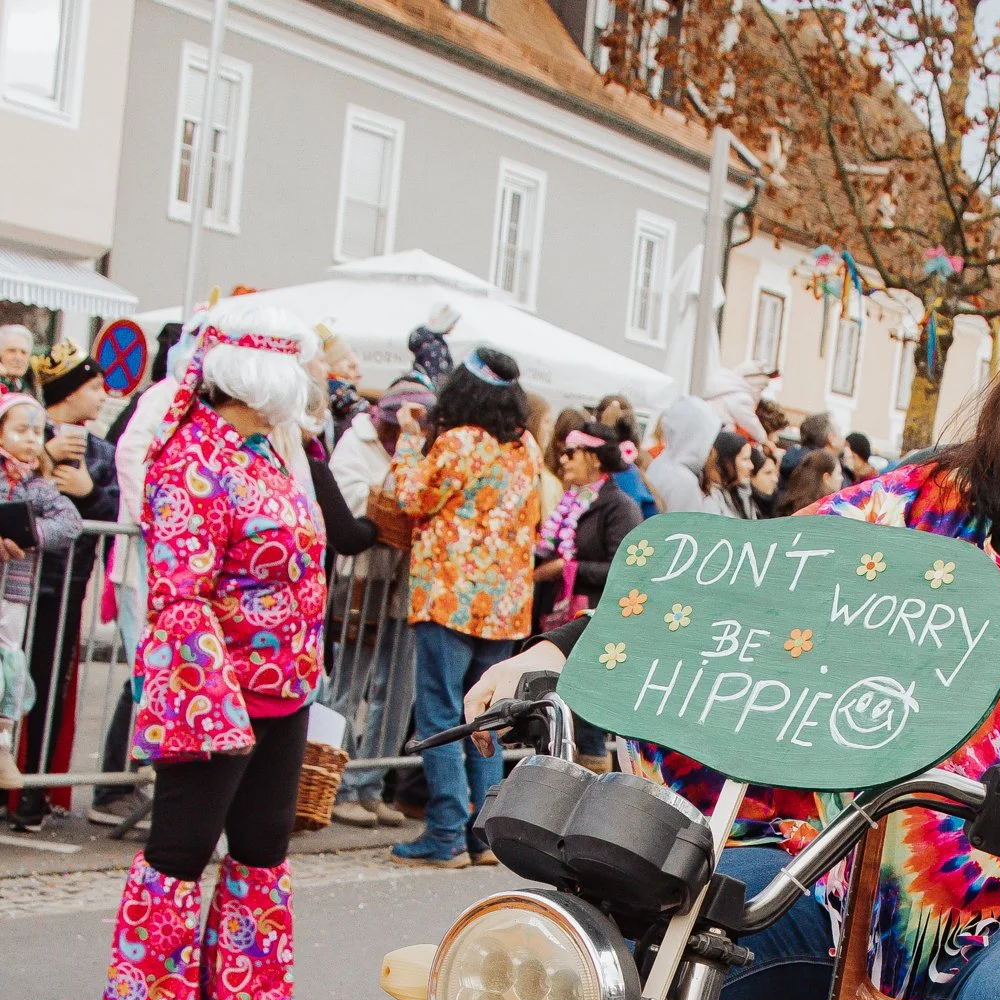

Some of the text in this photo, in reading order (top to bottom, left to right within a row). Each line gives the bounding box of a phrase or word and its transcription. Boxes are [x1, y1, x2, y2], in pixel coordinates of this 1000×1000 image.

[650, 532, 835, 592] DON'T
[701, 619, 770, 663] BE
[829, 583, 990, 688] WORRY
